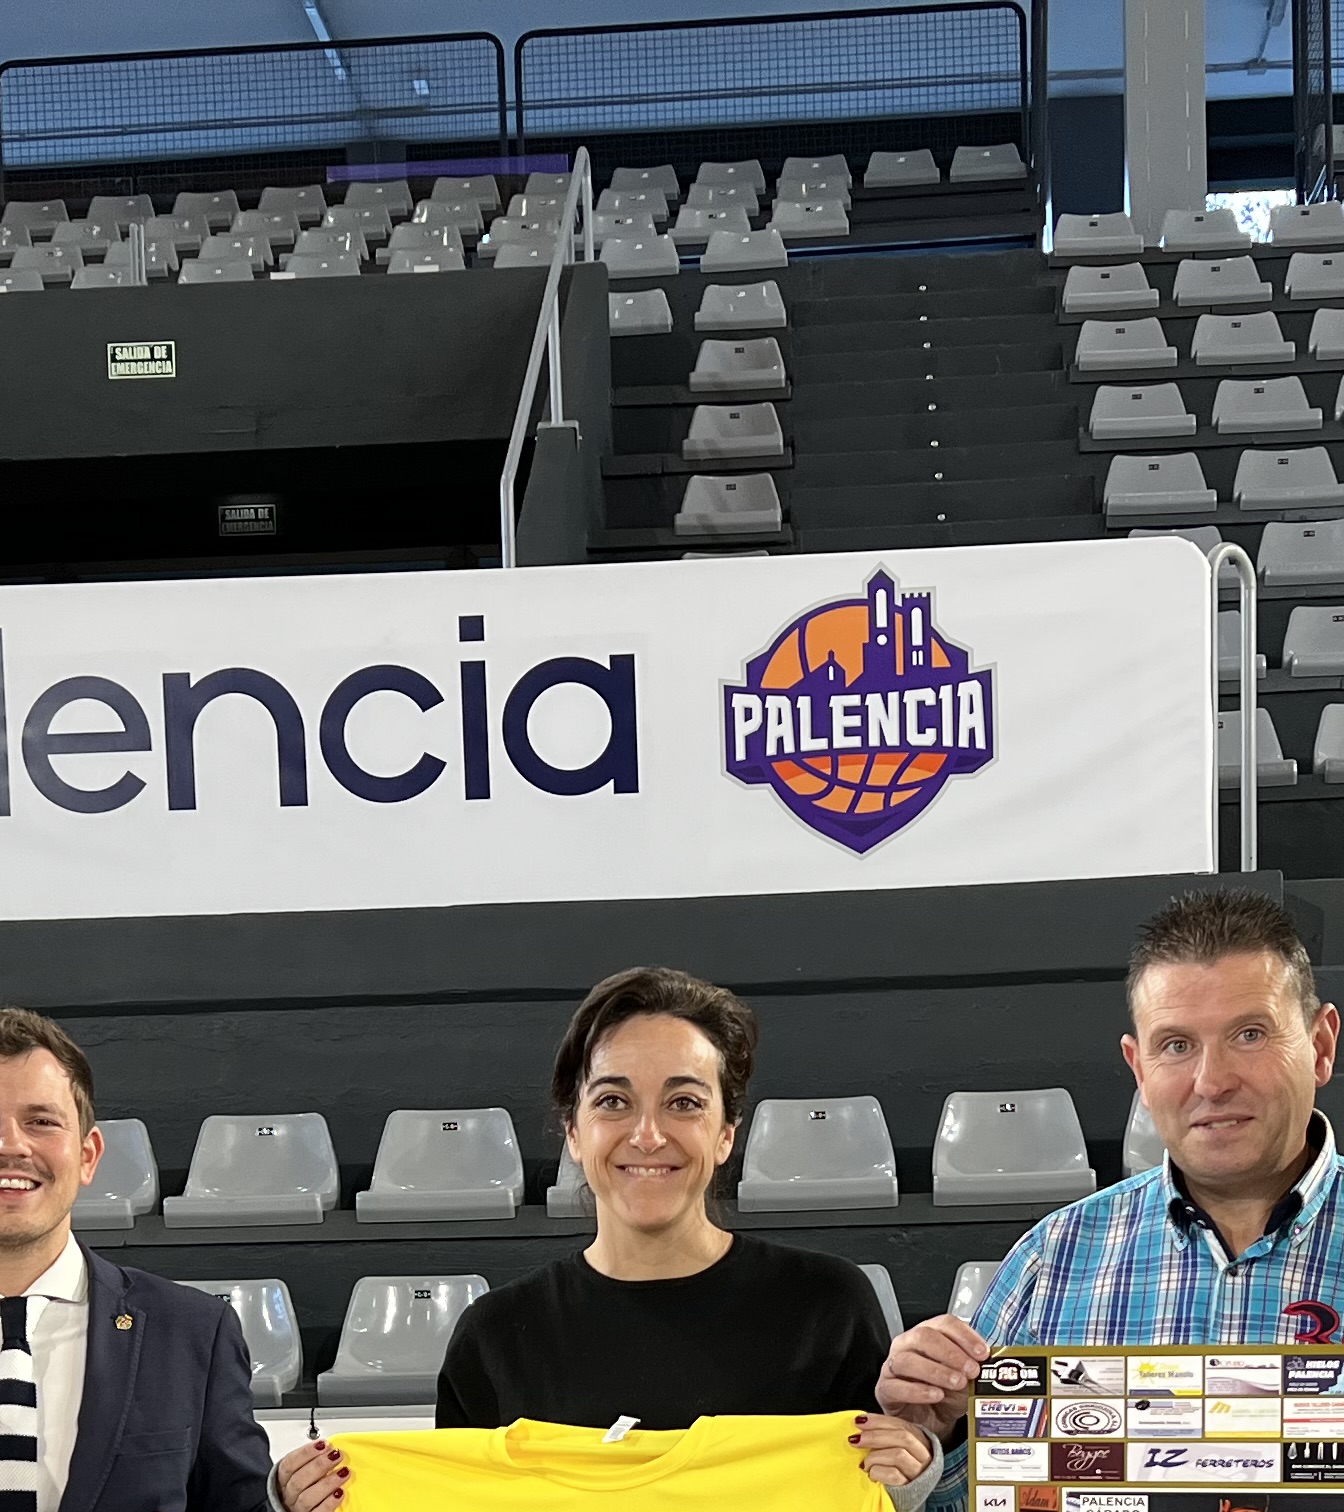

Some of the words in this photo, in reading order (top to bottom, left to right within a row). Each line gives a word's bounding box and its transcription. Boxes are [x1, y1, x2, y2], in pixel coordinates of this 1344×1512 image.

[115, 346, 151, 360] SALIDA
[153, 345, 167, 359] DE
[111, 361, 172, 376] EMERGENCIA
[225, 508, 255, 520] SALIDA
[258, 508, 269, 519] DE
[732, 679, 987, 762] PALENCIA
[1288, 1370, 1335, 1379] PALENCIA
[1196, 1458, 1275, 1468] FERRETEROS
[1082, 1496, 1146, 1507] PALENCIA
